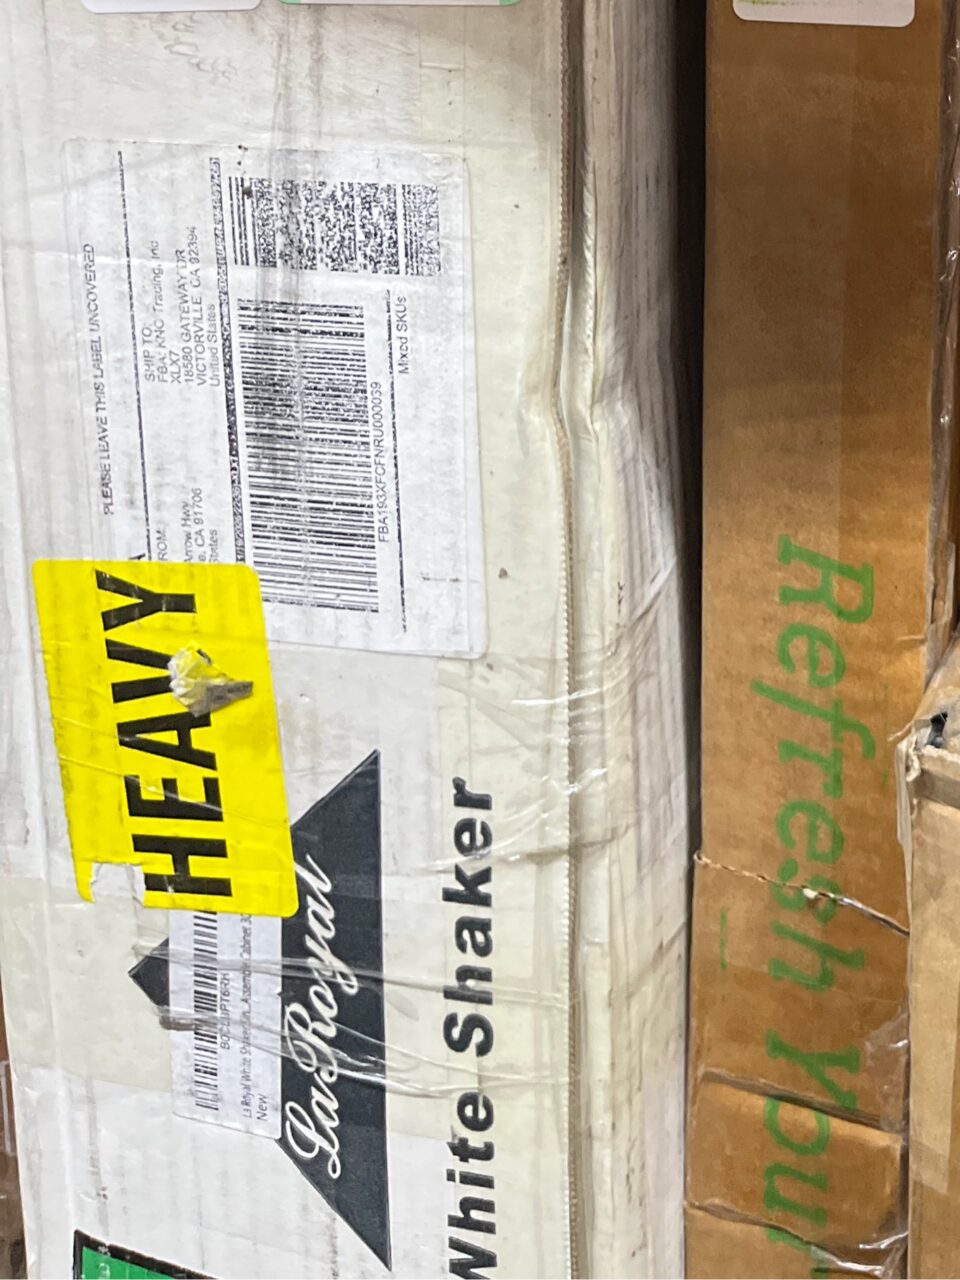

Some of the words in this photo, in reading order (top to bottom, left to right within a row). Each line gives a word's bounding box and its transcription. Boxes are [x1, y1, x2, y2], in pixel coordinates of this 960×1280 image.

[83, 243, 101, 332] UNCOVERED
[188, 268, 201, 288] CA
[177, 274, 192, 343] GATEWAY
[205, 303, 218, 343] States
[394, 295, 408, 332] SKUs
[89, 336, 103, 379] LABEL
[143, 349, 155, 382] SHIP
[169, 350, 181, 384] XLX7
[206, 347, 220, 387] United
[396, 336, 410, 375] Mixed
[92, 381, 107, 413] THIS
[96, 416, 110, 460] LEAVE
[99, 463, 114, 515] PLEASE
[194, 528, 206, 548] CA
[95, 568, 232, 897] HEAVY
[750, 533, 876, 993] Refresh
[442, 776, 495, 1058] Shaker
[257, 1094, 268, 1121] New
